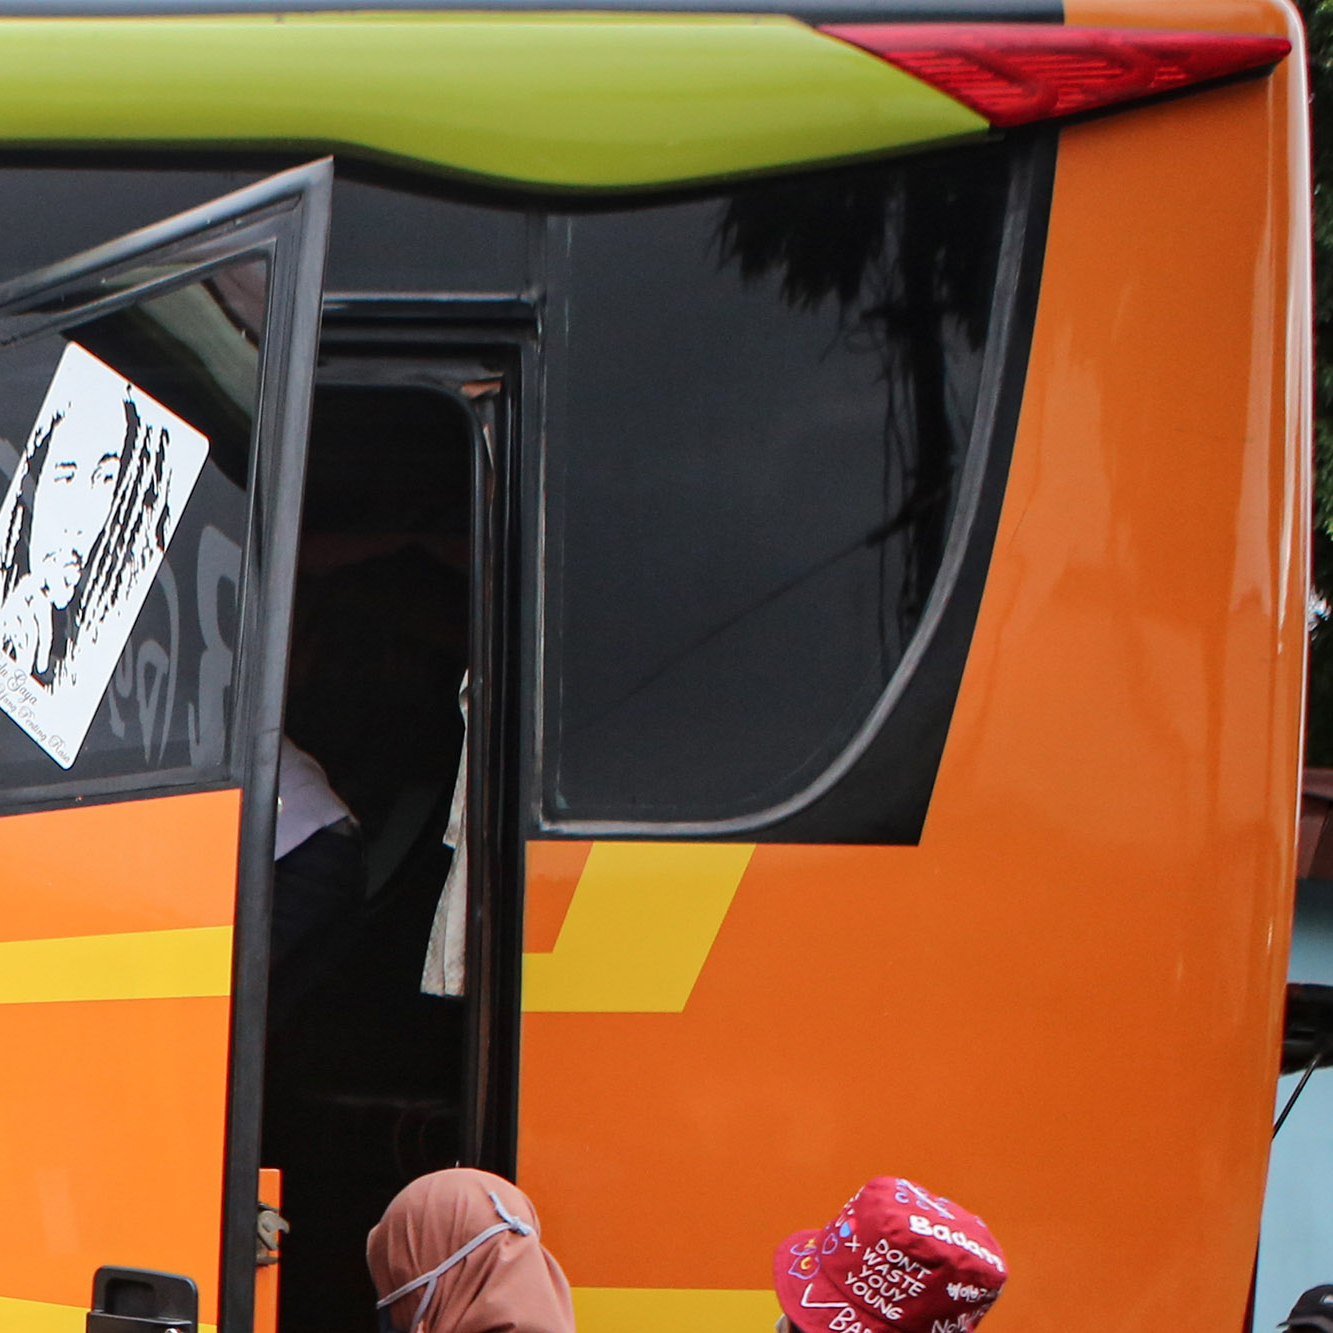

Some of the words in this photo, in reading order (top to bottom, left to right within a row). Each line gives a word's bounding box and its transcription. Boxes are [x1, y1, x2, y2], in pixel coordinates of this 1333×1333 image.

[863, 1247, 926, 1297] WASTE
[876, 1239, 931, 1280] DON'T
[845, 1271, 904, 1320] YOUNG
